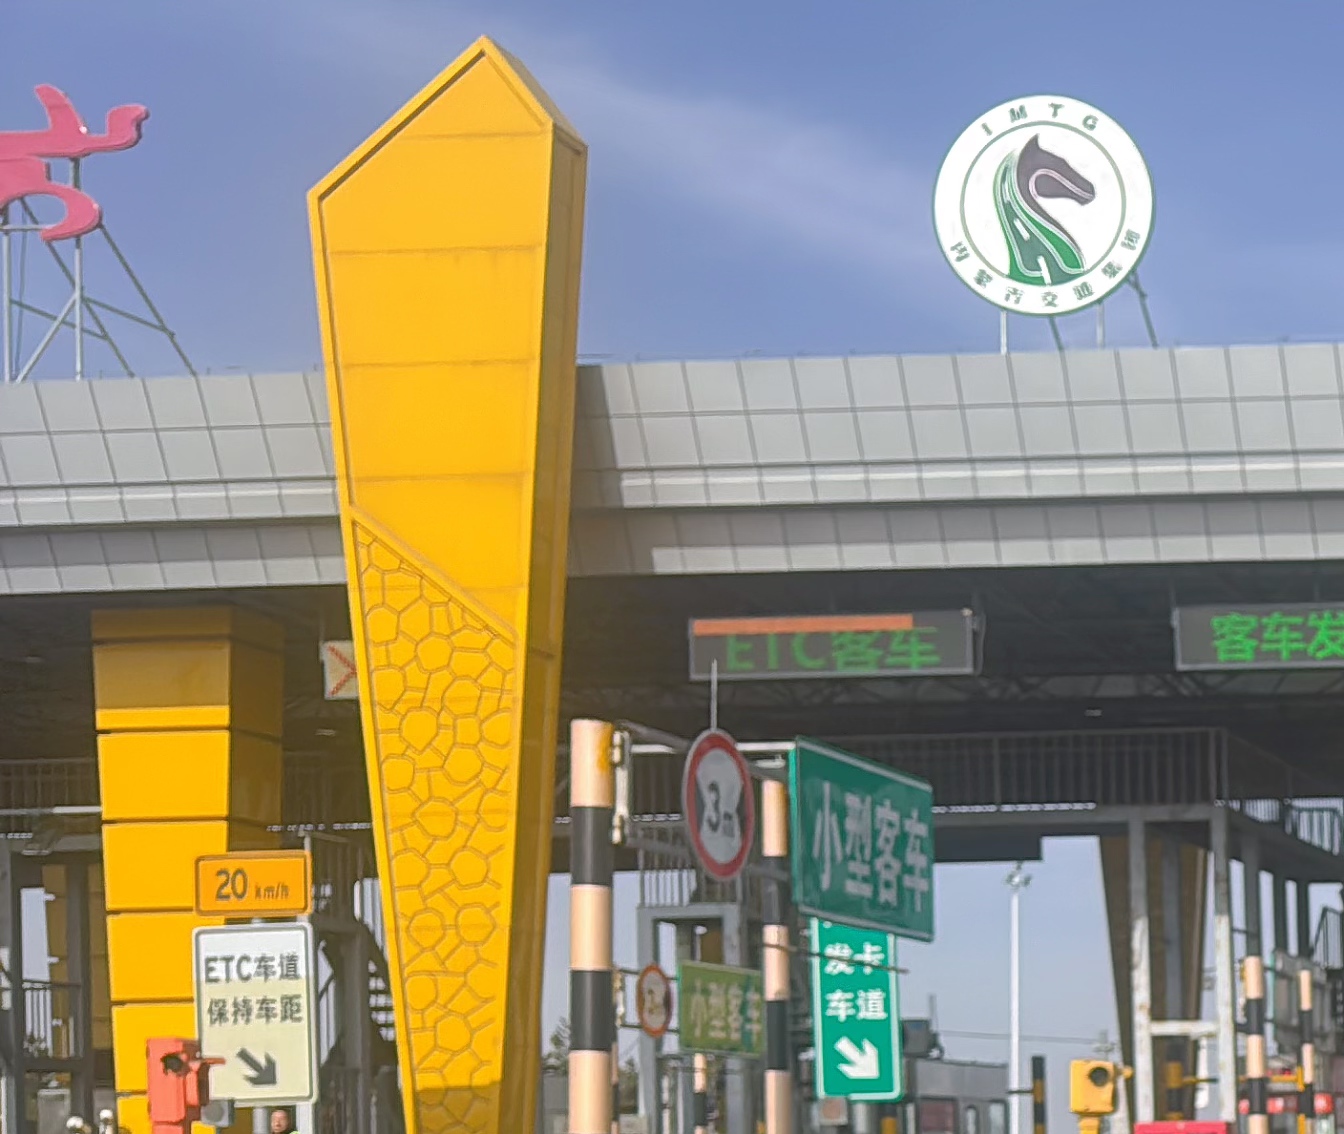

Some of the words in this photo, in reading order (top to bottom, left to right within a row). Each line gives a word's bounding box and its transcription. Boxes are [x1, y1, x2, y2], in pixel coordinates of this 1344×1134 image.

[983, 103, 1099, 136] IMTG
[813, 780, 930, 913] 小型客车
[215, 868, 248, 900] 20
[255, 883, 289, 900] km/h
[205, 953, 302, 983] ETC车道
[823, 942, 885, 975] 发卡
[208, 994, 303, 1026] 保持车距
[825, 989, 888, 1022] 车道
